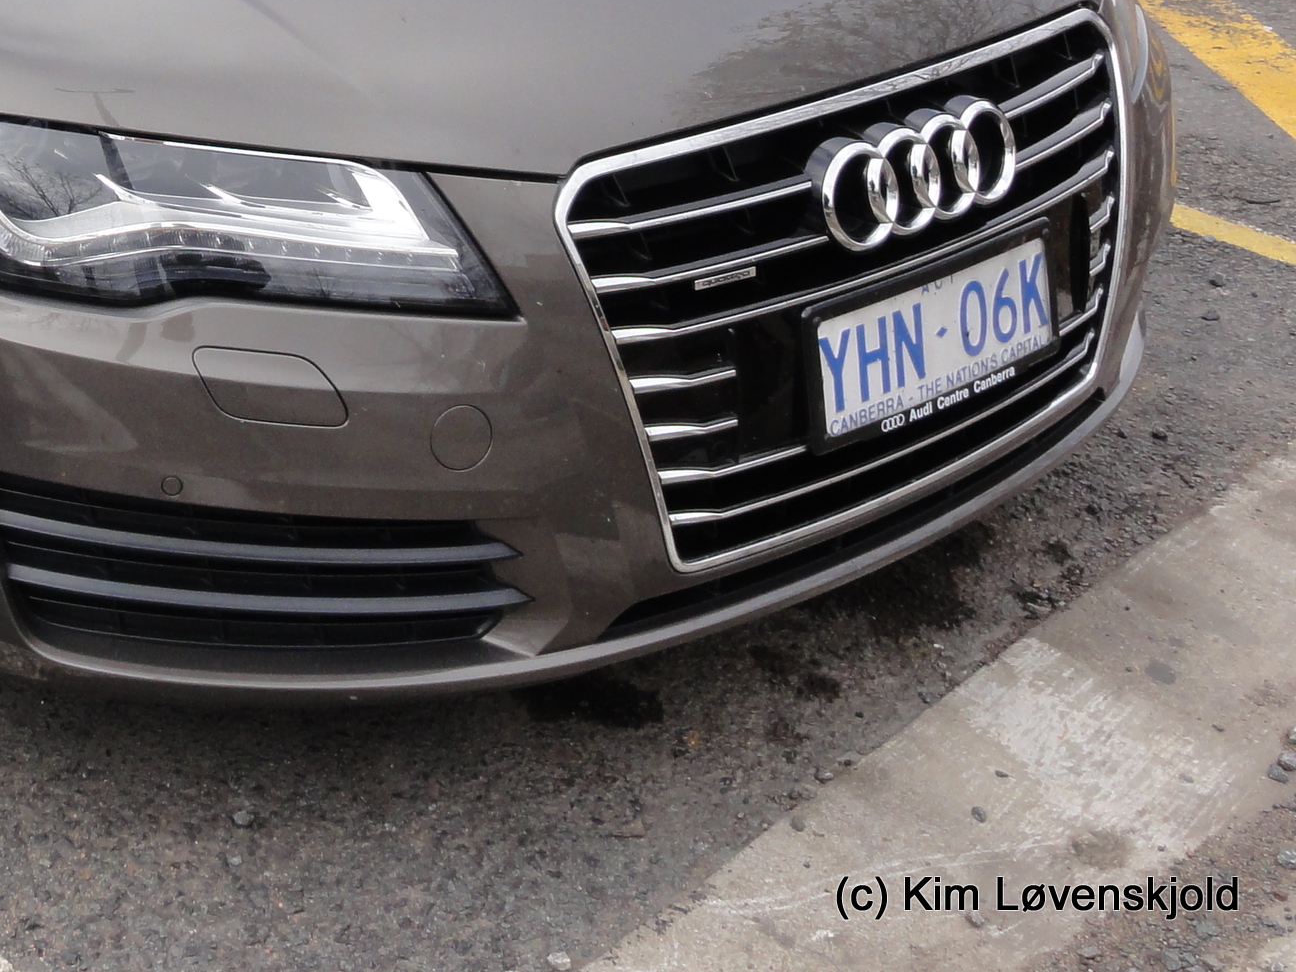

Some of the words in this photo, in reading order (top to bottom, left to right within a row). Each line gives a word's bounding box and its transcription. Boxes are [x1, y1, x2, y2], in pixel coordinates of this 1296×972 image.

[818, 302, 926, 413] YHN
[959, 251, 1049, 357] 06K
[830, 394, 904, 436] CANBERRA
[917, 377, 943, 403] THE
[1001, 334, 1045, 365] CAPITAL
[909, 401, 933, 422] Audi
[937, 387, 970, 410] Centre
[973, 366, 1016, 393] Canberra
